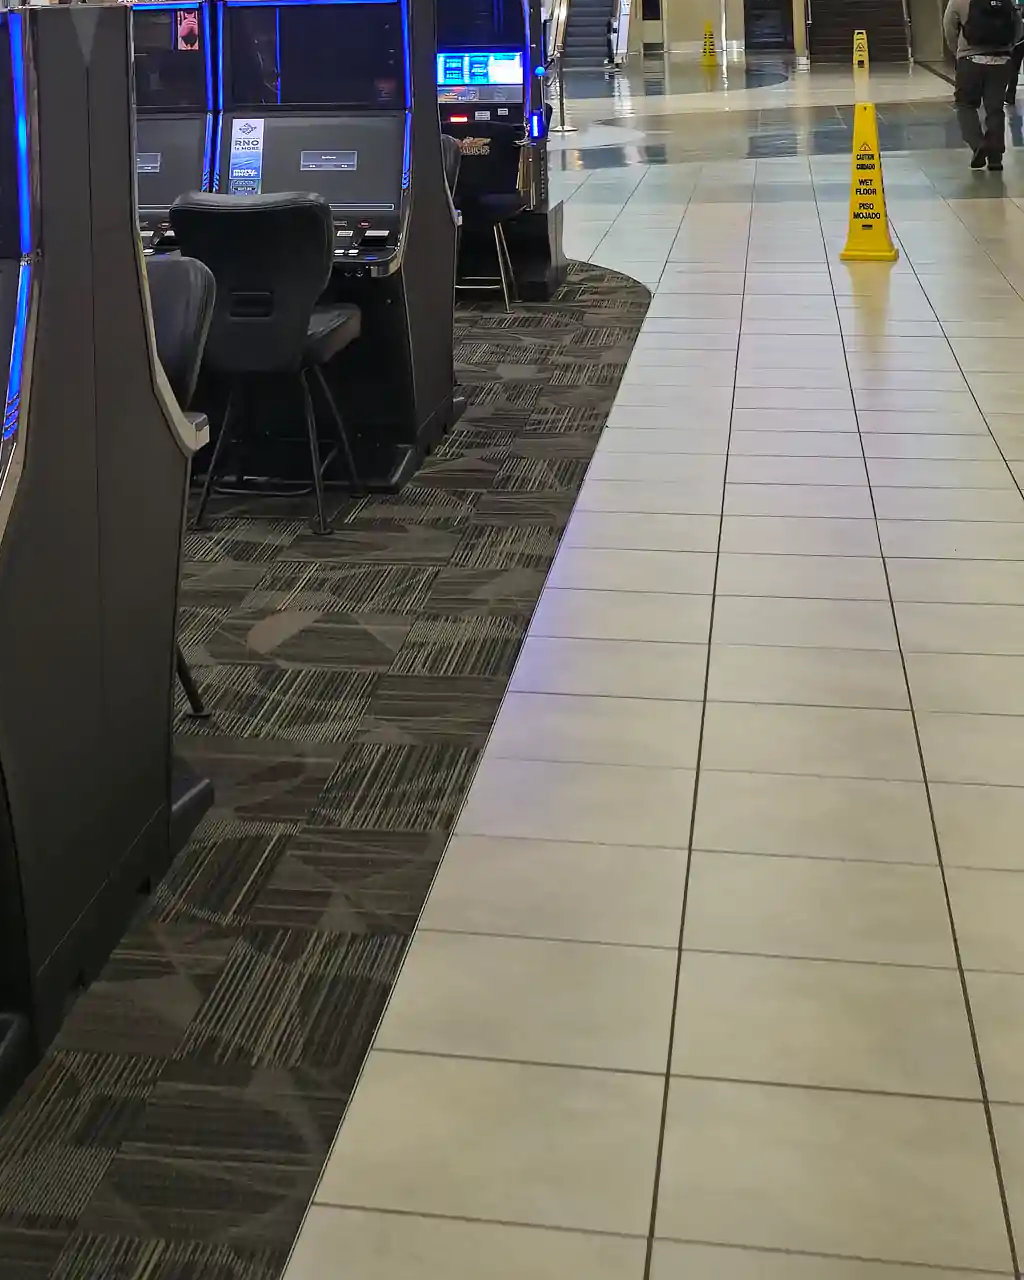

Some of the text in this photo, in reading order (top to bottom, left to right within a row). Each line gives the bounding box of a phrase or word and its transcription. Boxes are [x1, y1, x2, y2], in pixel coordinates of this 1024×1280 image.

[855, 188, 877, 196] FLOOR
[858, 202, 874, 210] PISO
[852, 212, 881, 220] MOJADO
